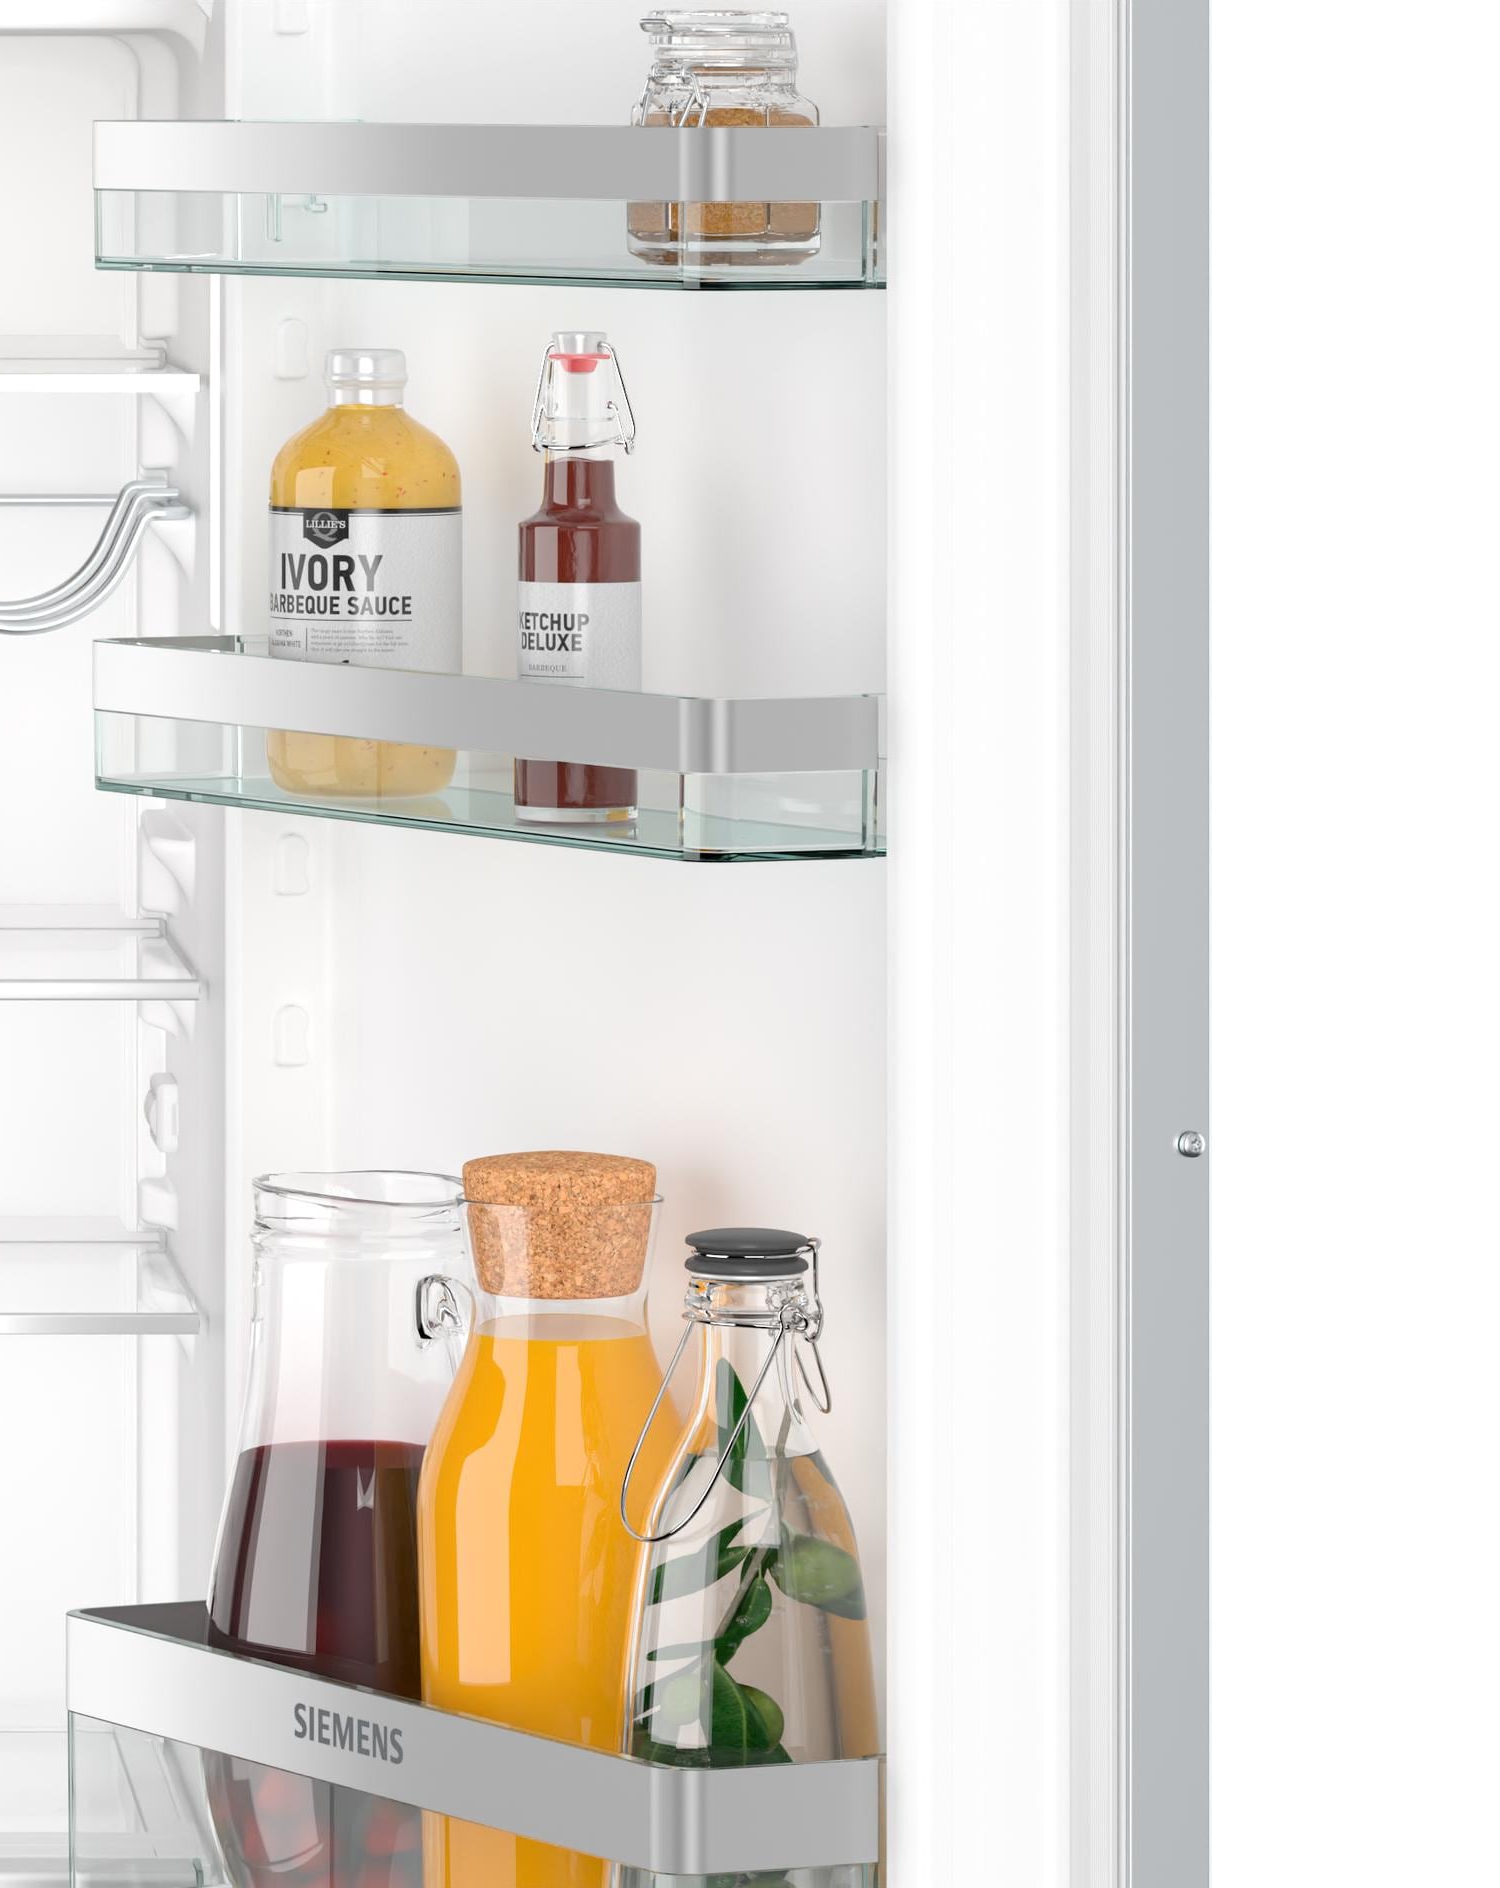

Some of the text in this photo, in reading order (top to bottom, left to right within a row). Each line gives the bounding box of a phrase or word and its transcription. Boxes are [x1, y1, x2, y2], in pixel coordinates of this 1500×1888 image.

[305, 519, 347, 529] LILLIE'S
[281, 552, 384, 592] IVORY
[347, 595, 412, 616] SAUCE
[519, 611, 590, 631] KETCHUP
[521, 631, 583, 652] DELUXE
[293, 1702, 404, 1765] SIEMENS
